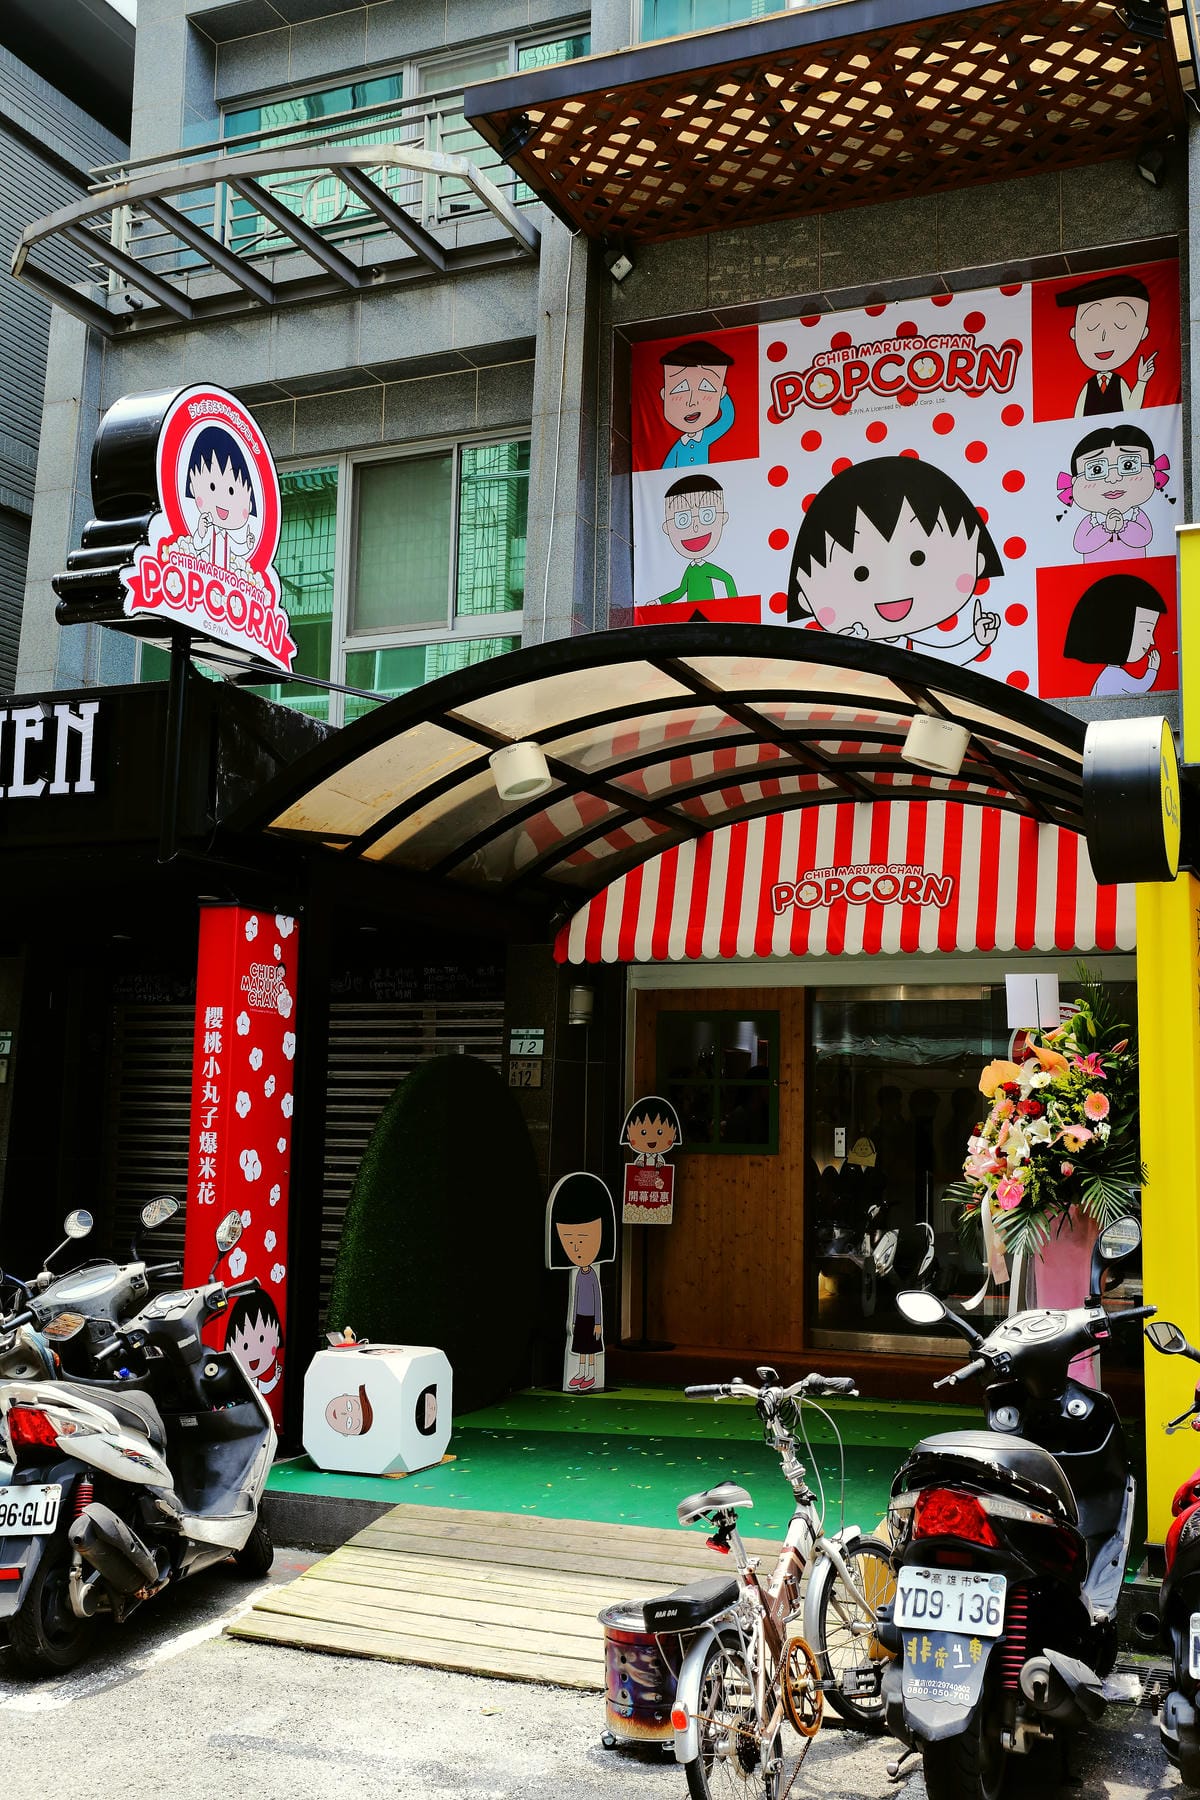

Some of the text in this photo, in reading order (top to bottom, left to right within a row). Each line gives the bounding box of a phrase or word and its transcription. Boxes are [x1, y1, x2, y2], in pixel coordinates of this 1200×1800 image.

[815, 334, 973, 368] CHIBI MARUKO CHAN
[773, 347, 1018, 417] POPCORN
[170, 554, 265, 605] CHIBI MARUKO CHAN
[141, 559, 285, 653] POPCORN
[0, 702, 100, 798] EN
[804, 864, 923, 881] CHIBI MARUKO CHAN
[773, 874, 952, 914] POPCORN
[241, 975, 286, 994] MARUKO
[248, 991, 279, 1009] CHAN
[518, 1040, 537, 1053] 12
[518, 1070, 532, 1086] 12
[197, 1006, 223, 1205] 櫻桃小丸子爆米花
[628, 1191, 669, 1202] 開幕優惠
[930, 1573, 973, 1587] 高雄市
[907, 1686, 970, 1700] 0800-050-700
